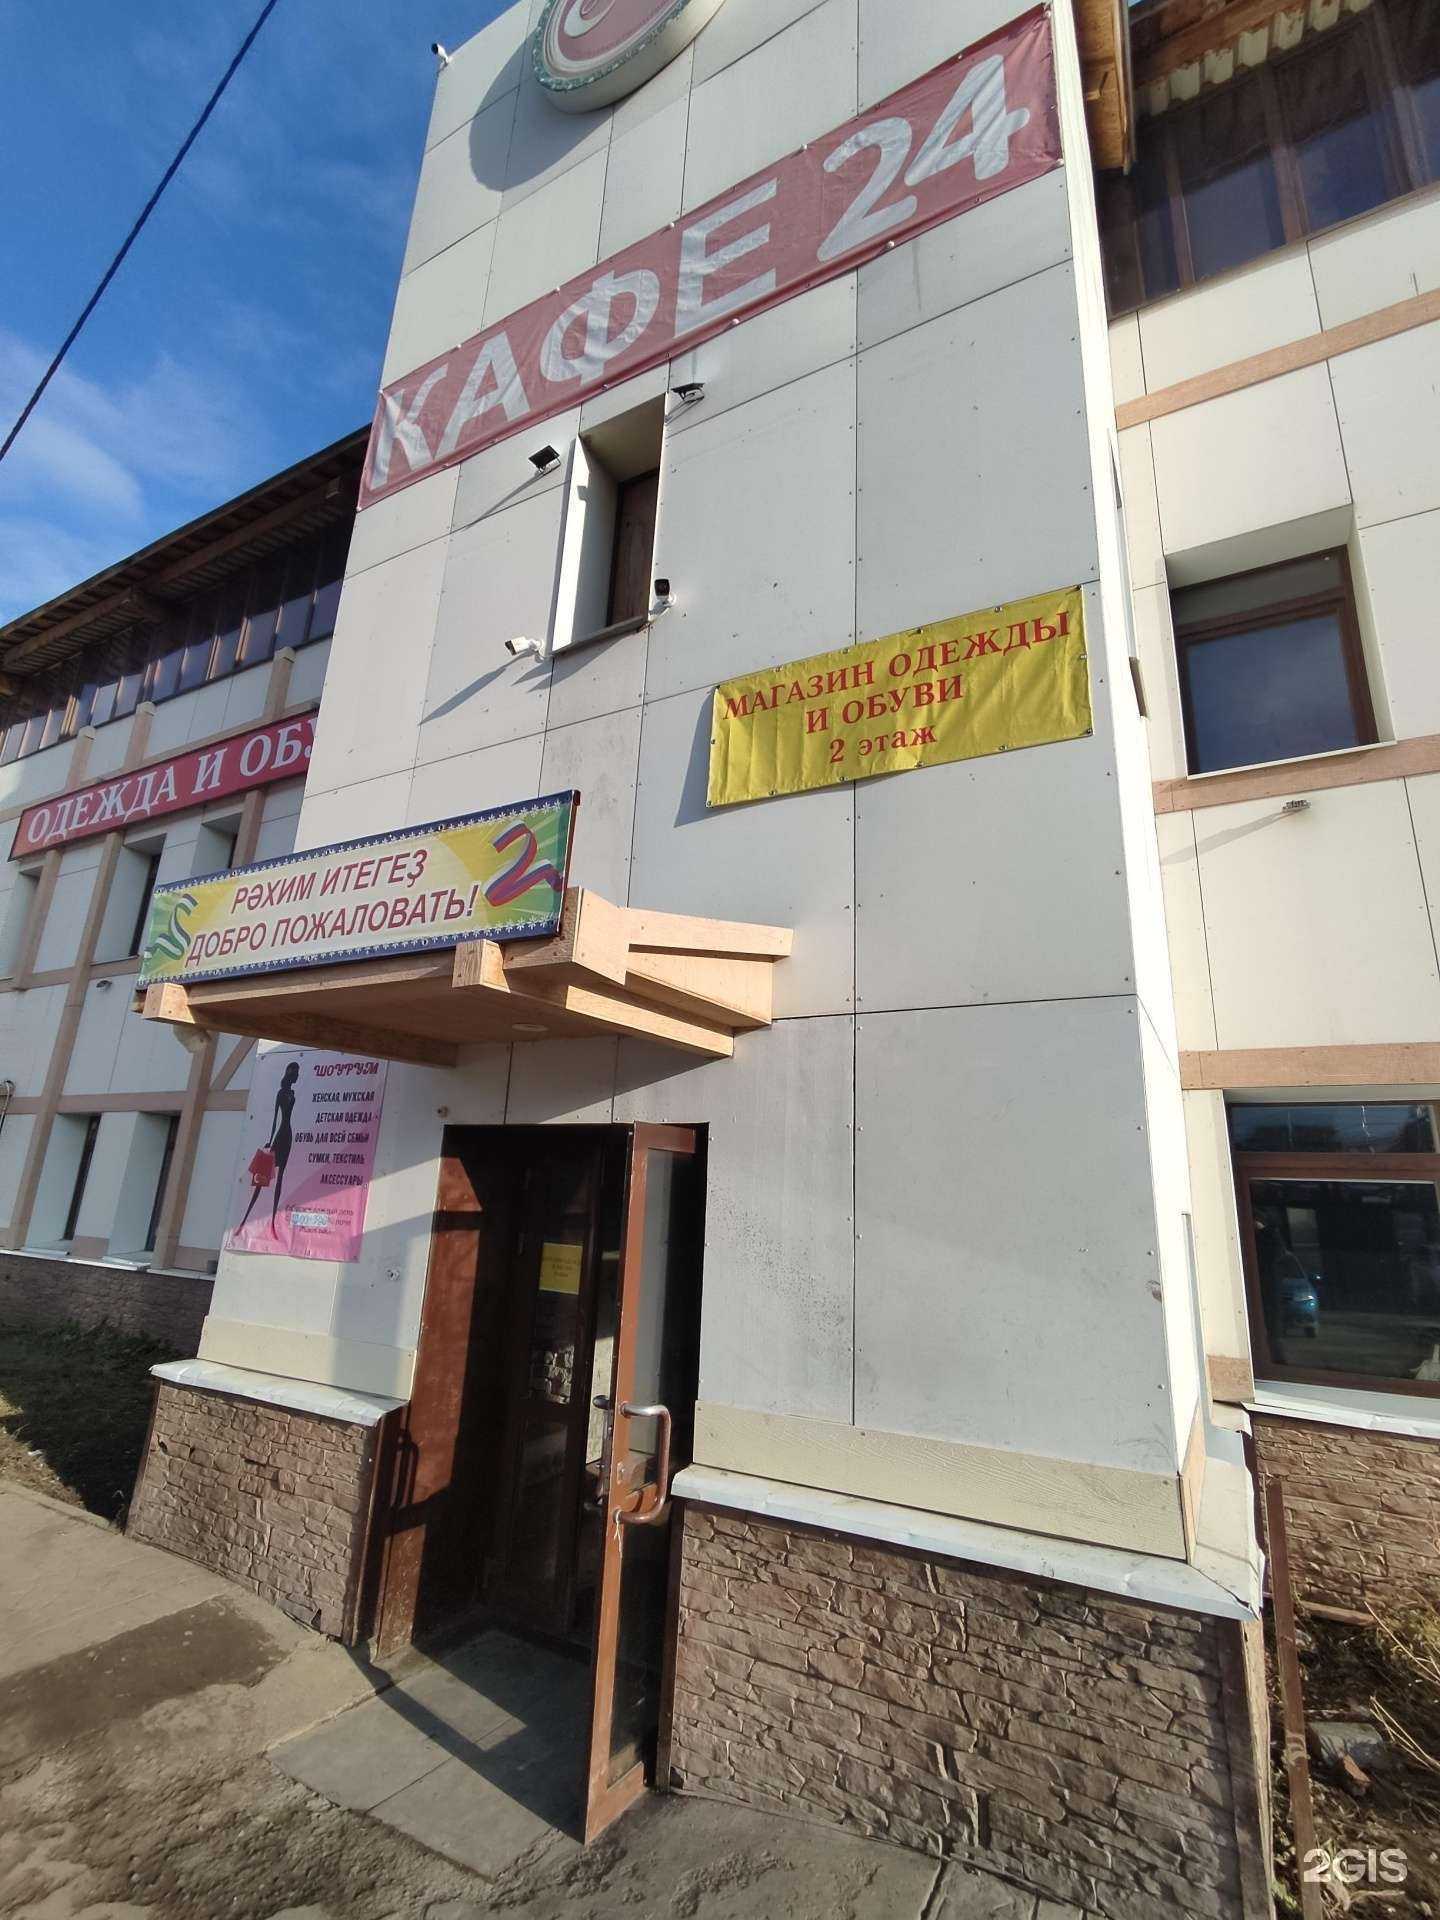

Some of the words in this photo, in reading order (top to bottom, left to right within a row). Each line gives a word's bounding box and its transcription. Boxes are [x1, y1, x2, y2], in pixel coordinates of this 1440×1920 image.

[370, 176, 780, 490] КАФЕ
[817, 54, 1029, 263] 24
[723, 660, 874, 721] МАГАЗИН
[888, 610, 1070, 678] ОДЕЖДЫ
[806, 708, 828, 734] И
[841, 674, 964, 725] ОБУВИ
[829, 738, 845, 763] 2
[858, 724, 937, 758] этаж
[27, 765, 177, 846] ОДЕЖДА
[191, 748, 228, 794] И
[231, 872, 317, 914] РӘХИМ
[185, 922, 266, 968] ДОБРО
[270, 884, 480, 948] ПОЖАЛОВАТЬ!
[313, 1062, 379, 1077] ШОУРУМ
[342, 1091, 375, 1102] МУЖСКАЯ
[295, 1132, 313, 1143] ОБУВЬ
[315, 1133, 328, 1144] ДЛЯ
[329, 1130, 346, 1143] ВСЕЙ
[315, 1112, 343, 1123] ДЕТСКАЯ
[344, 1112, 372, 1123] ОДЕЖДА
[333, 1153, 365, 1164] ТЕКСТИЛЬ
[319, 1173, 364, 1186] АКСЕССУАРЫ
